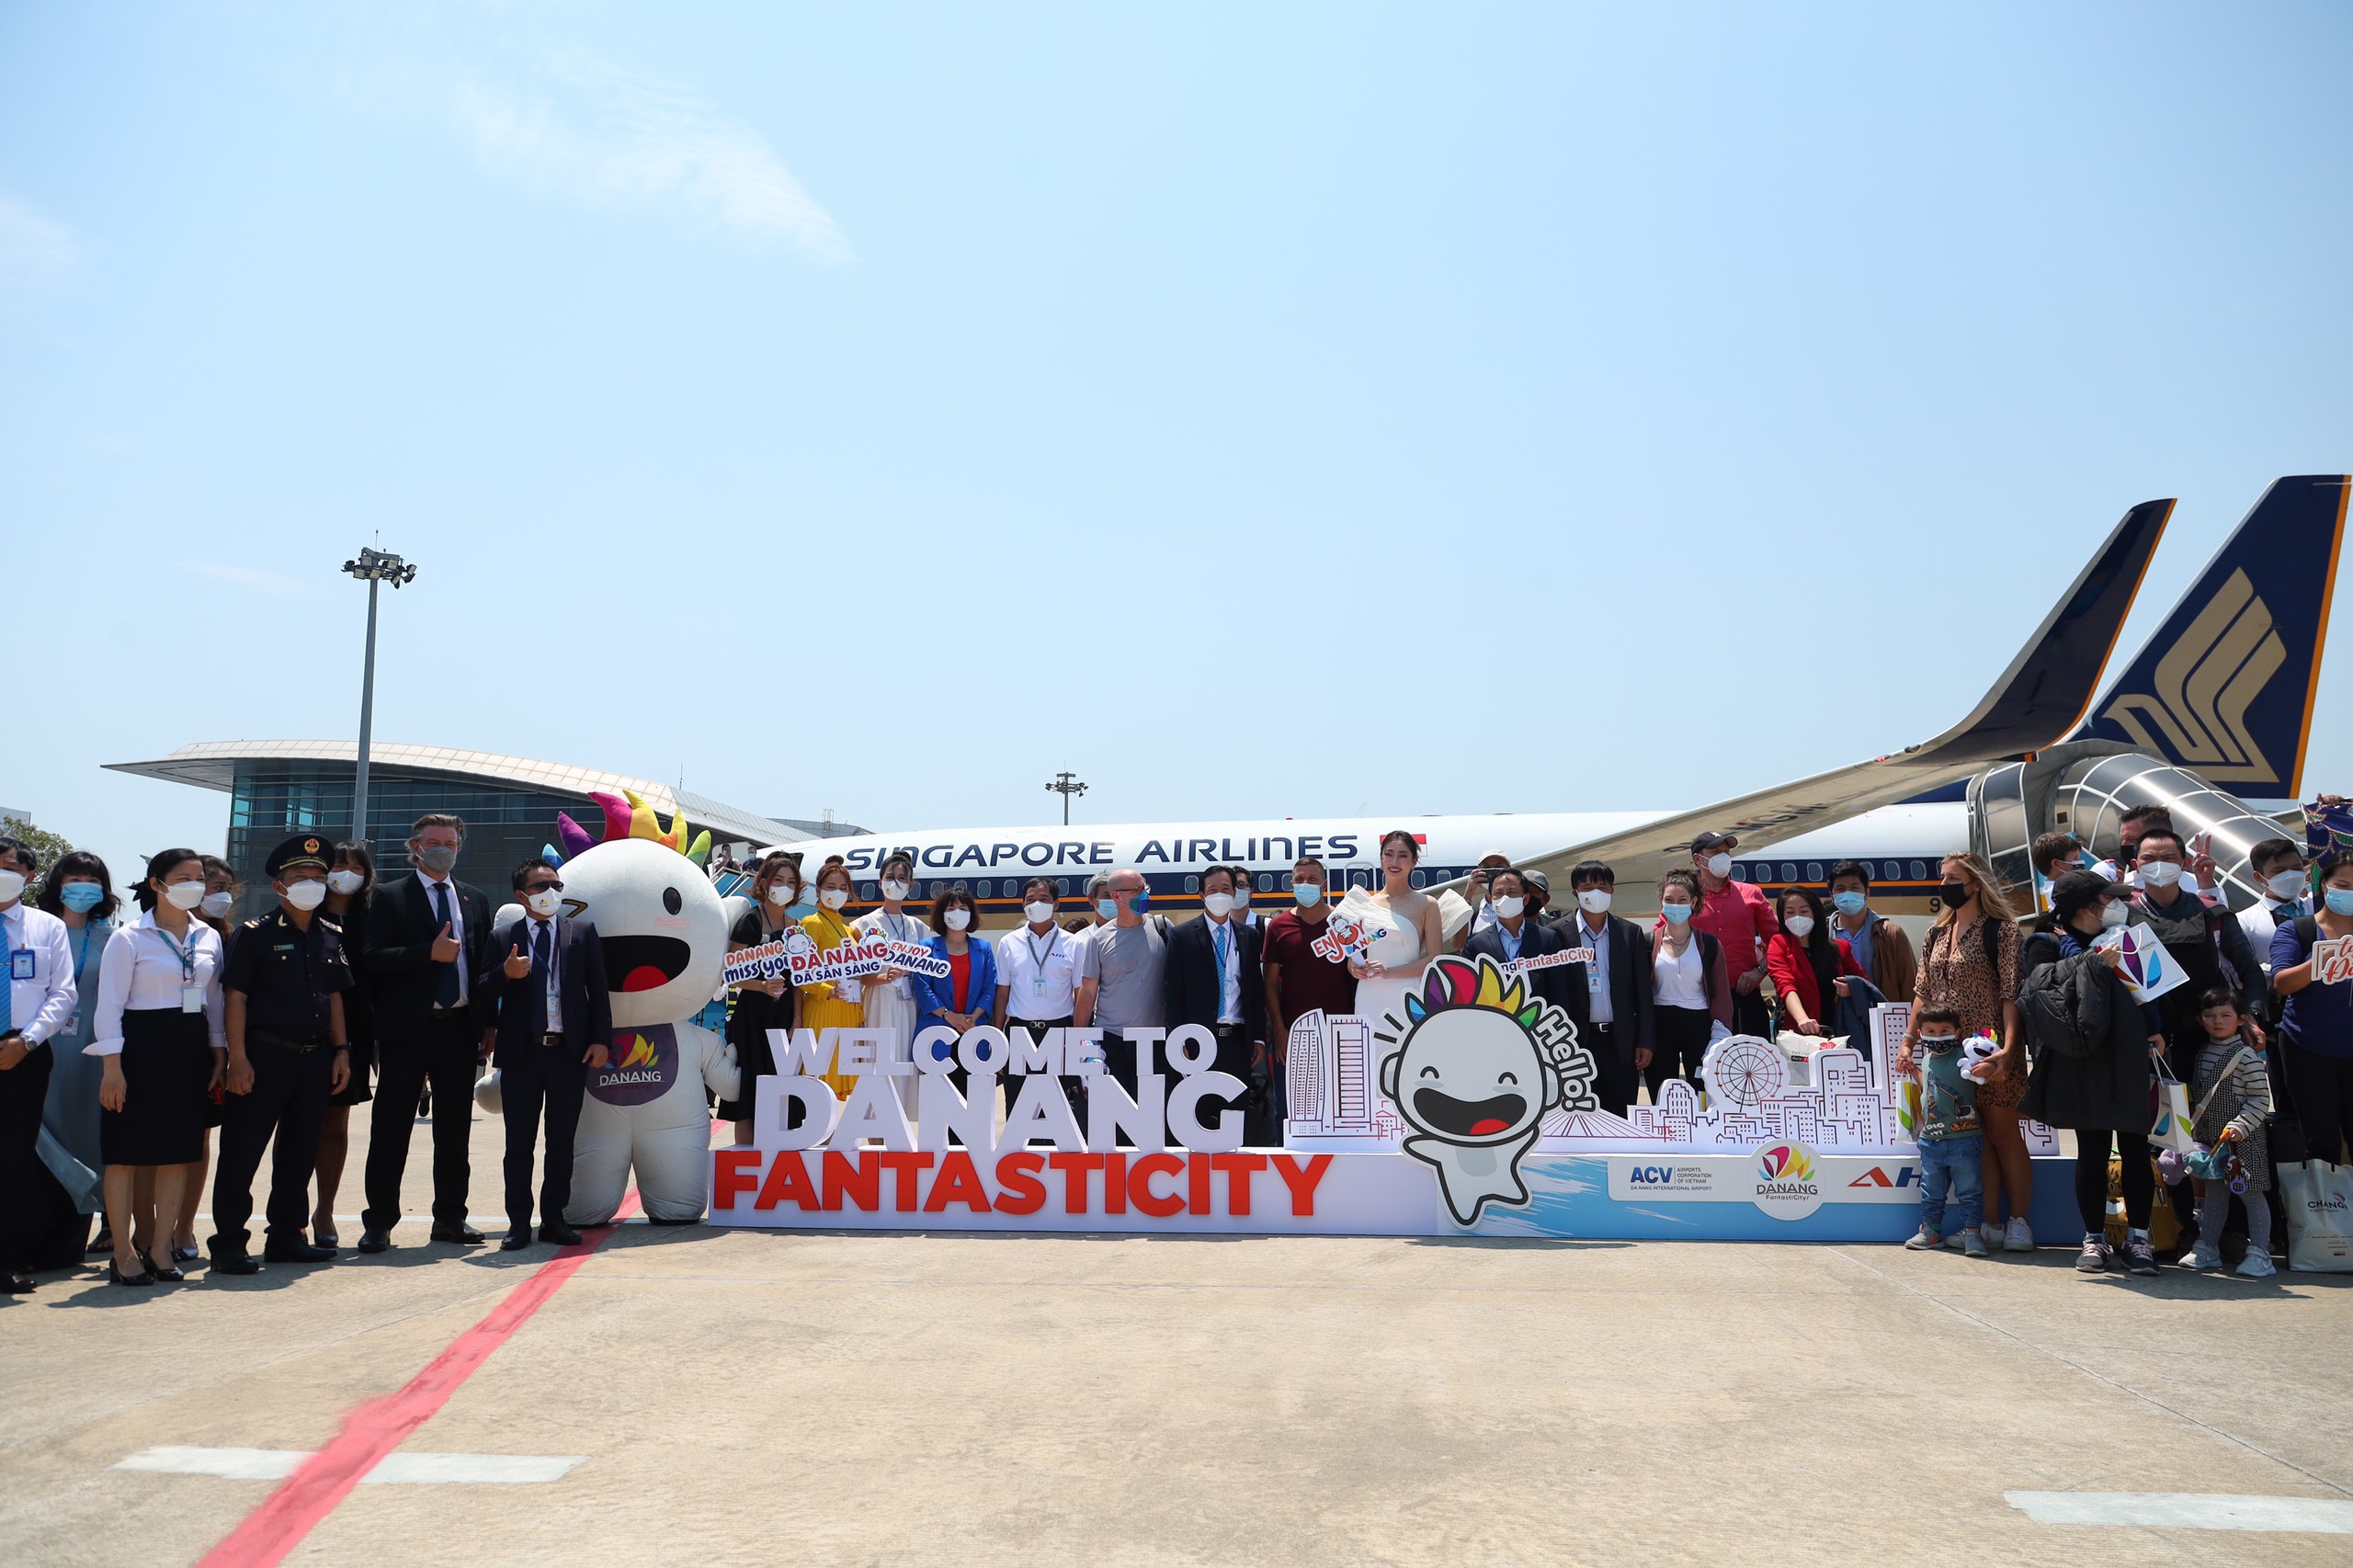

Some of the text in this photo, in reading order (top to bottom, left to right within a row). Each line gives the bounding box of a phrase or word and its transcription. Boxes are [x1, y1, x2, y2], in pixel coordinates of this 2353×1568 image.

[846, 835, 1358, 870] SINGAPORE AIRLINES
[826, 939, 888, 966] NẴNG
[890, 941, 929, 958] ENJOY
[1313, 919, 1366, 961] ENJOY
[726, 941, 783, 967] DANANG
[882, 950, 949, 975] DANANG
[724, 963, 759, 983] miss
[846, 961, 880, 975] SÀNG
[767, 1024, 1218, 1077] WELCOME TO
[1534, 1011, 1597, 1111] Hello!
[599, 1071, 662, 1087] DANANG
[754, 1071, 1248, 1153] DANANG
[713, 1151, 1335, 1218] FANTASTICITY
[1630, 1166, 1673, 1184] ACV
[1847, 1166, 1922, 1187] AH
[1756, 1183, 1818, 1196] DANANG
